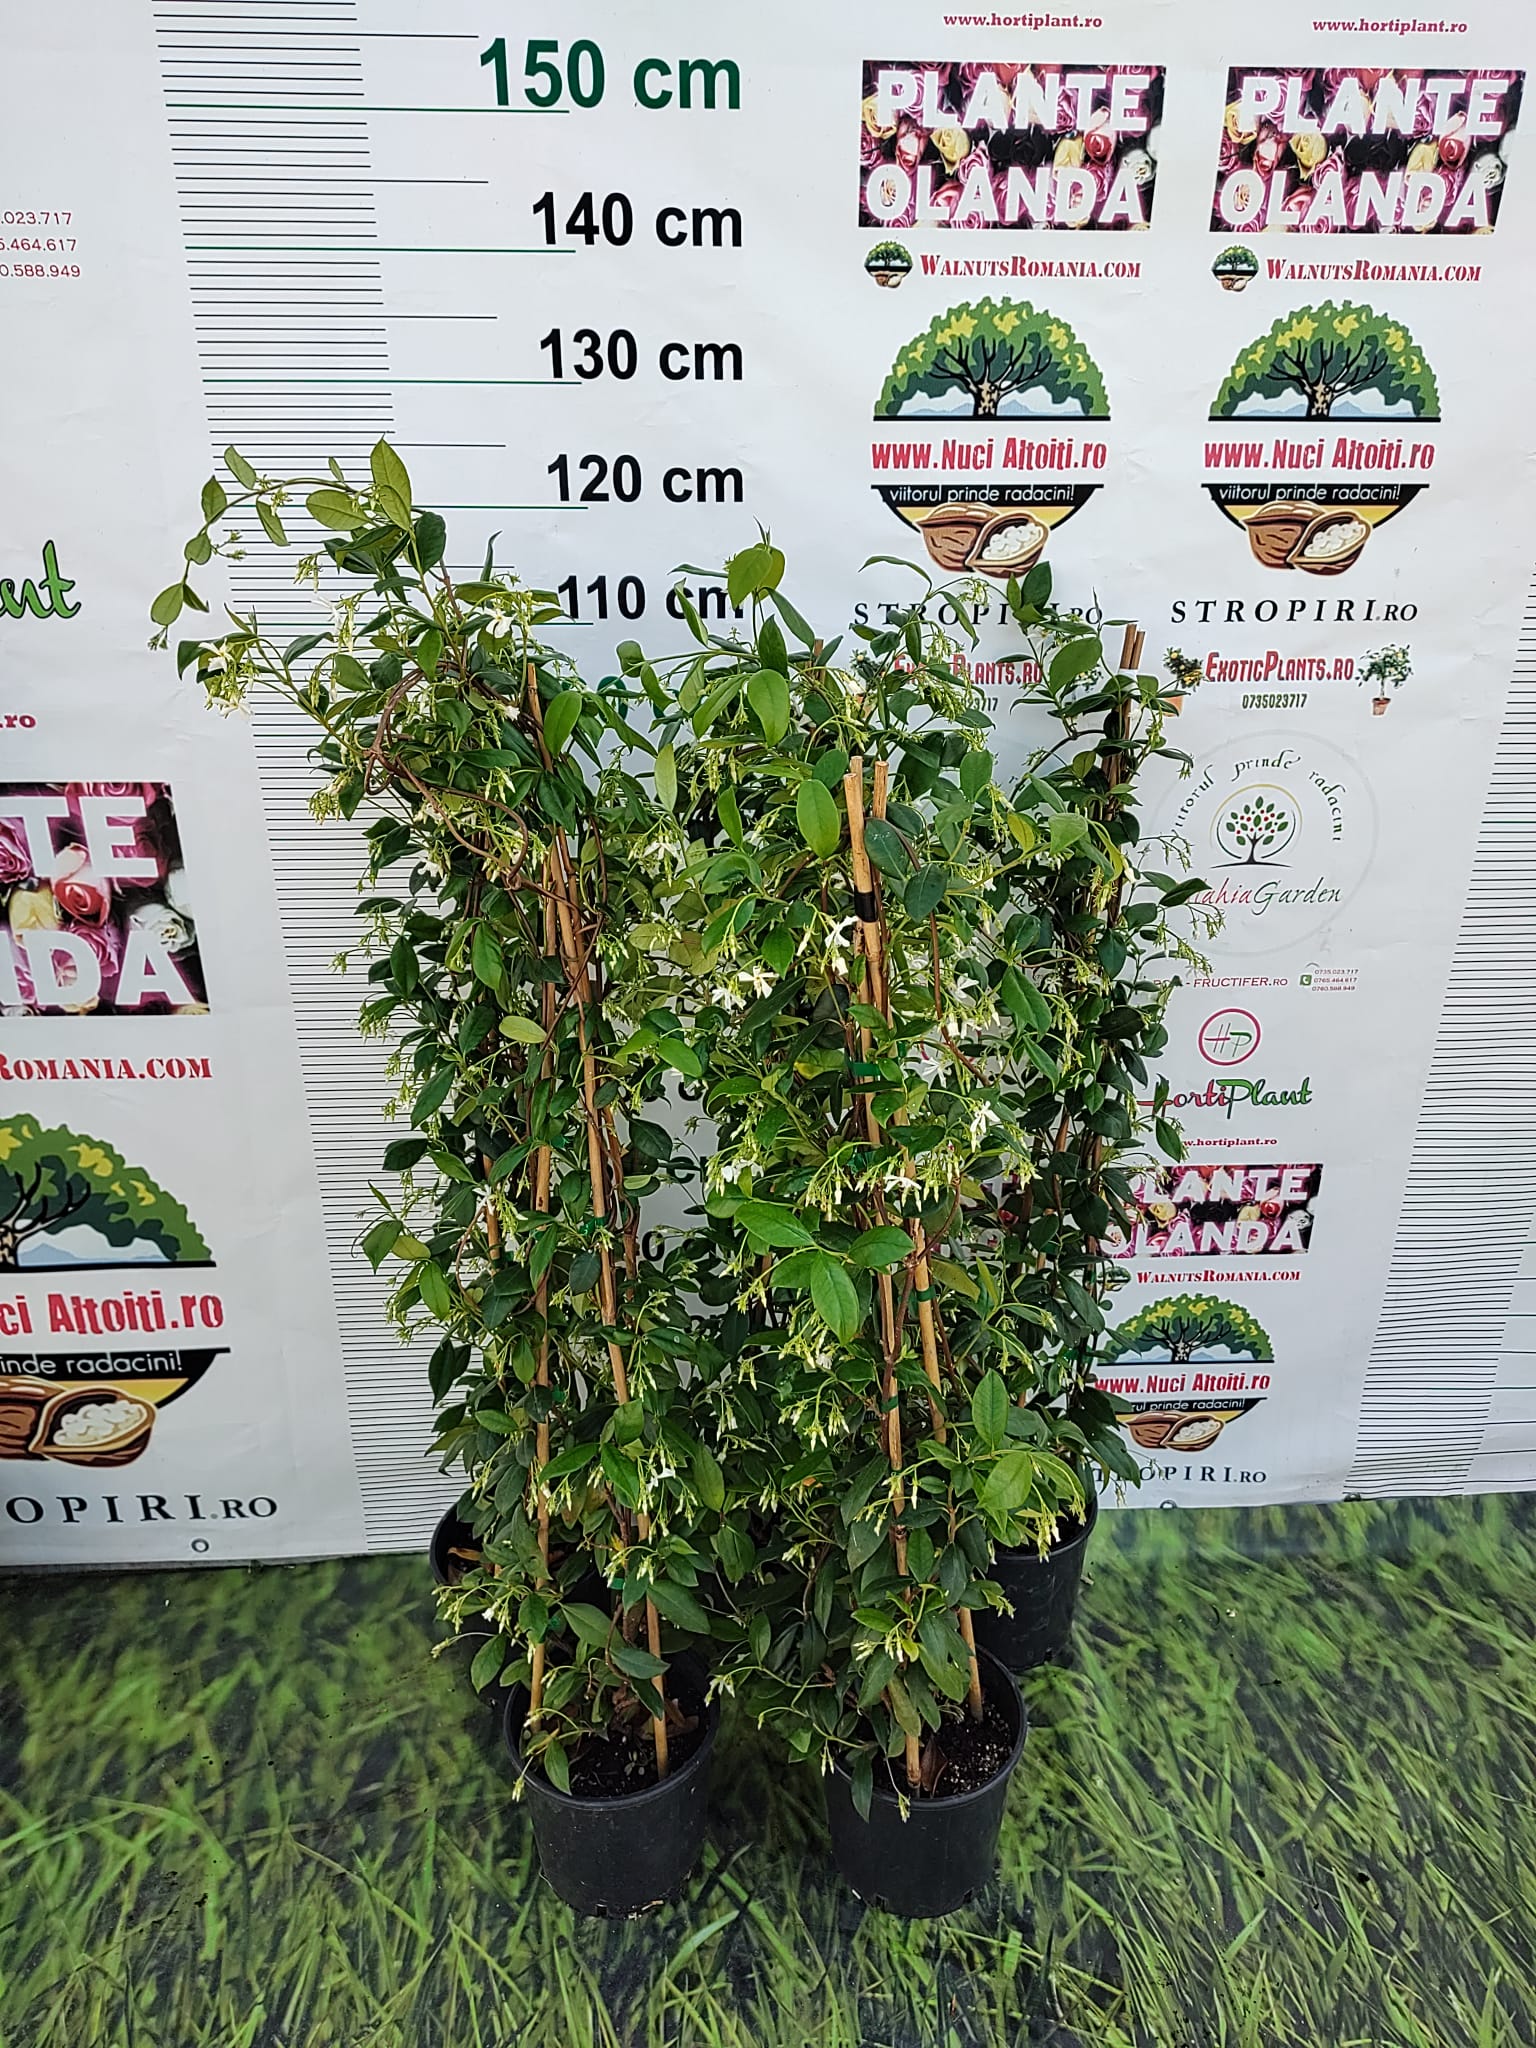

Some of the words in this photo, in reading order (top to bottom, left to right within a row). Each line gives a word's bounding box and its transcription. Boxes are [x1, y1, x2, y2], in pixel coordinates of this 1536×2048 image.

[943, 13, 1103, 30] www.hortiplant.ro
[1312, 19, 1468, 35] www.hortiplant.ro
[480, 37, 605, 108] 150
[633, 57, 741, 109] cm
[877, 71, 1152, 132] PLANTE
[1243, 76, 1509, 136] PLANTE
[866, 166, 1145, 224] OLANDA
[1221, 171, 1490, 227] OLANDA
[532, 192, 633, 246] 140
[656, 207, 742, 247] cm
[540, 328, 637, 380] 130
[659, 341, 742, 380] cm
[871, 438, 994, 470] www.Nuci
[1003, 437, 1107, 470] Altoiti.ro
[1204, 439, 1326, 470] www.Nuci
[1332, 437, 1435, 470] Altoiti.ro
[547, 454, 642, 502] 120
[662, 468, 743, 502] cm
[889, 485, 942, 503] viitorul
[947, 485, 1000, 503] prinde
[1004, 484, 1075, 502] radacini!
[1219, 484, 1271, 502] viitorul
[1276, 485, 1328, 502] prinde
[1332, 483, 1400, 501] radacini!
[558, 575, 645, 620] 110
[666, 584, 743, 619] cm
[1171, 600, 1419, 623] STROPIRI.RO
[1242, 694, 1308, 709] 0735023717
[1231, 749, 1301, 782] prinde
[1308, 770, 1346, 842] radacini
[1194, 977, 1288, 988] FRUCTIFER.RO
[47, 1291, 225, 1335] Altoiti.ro
[66, 1350, 183, 1374] radacini!
[1095, 1374, 1186, 1394] www.Nuci
[1192, 1373, 1271, 1392] Altoiti.ro
[1150, 1400, 1189, 1411] prinde
